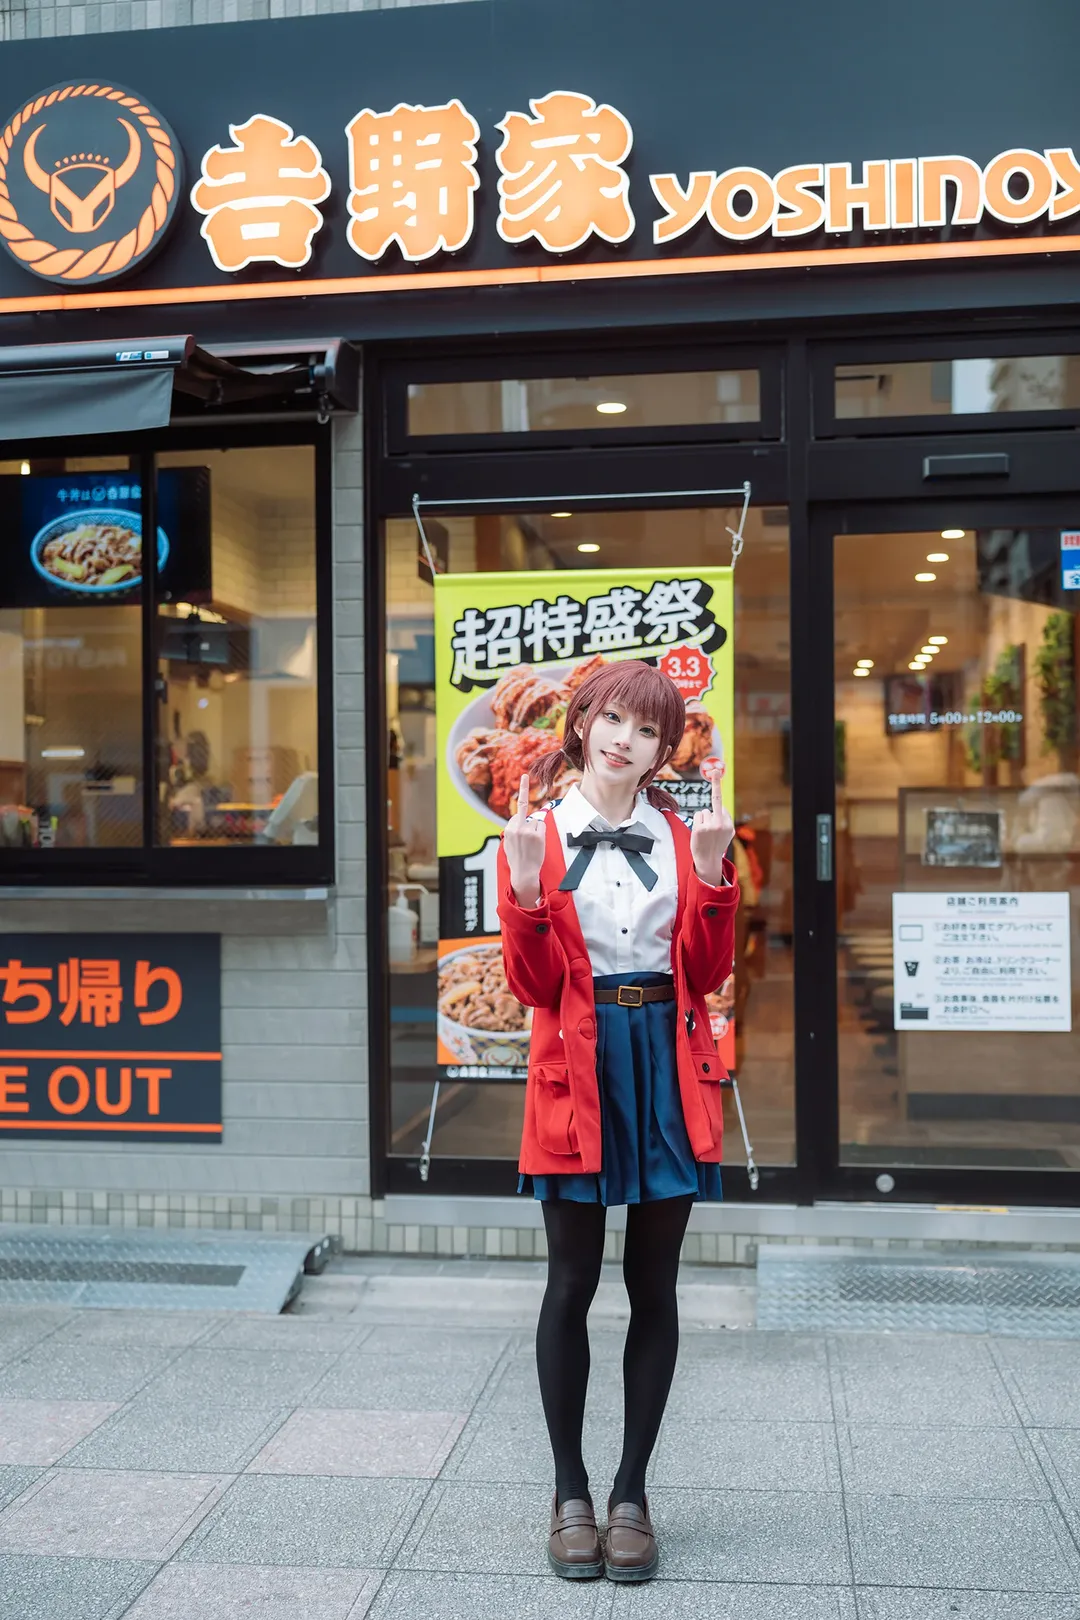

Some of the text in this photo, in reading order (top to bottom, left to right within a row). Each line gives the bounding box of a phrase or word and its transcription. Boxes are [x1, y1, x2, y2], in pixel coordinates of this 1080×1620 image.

[452, 579, 716, 684] 超特盛祭
[667, 656, 701, 677] 3.3
[0, 957, 183, 1027] ち帰り
[48, 1065, 172, 1115] OUT
